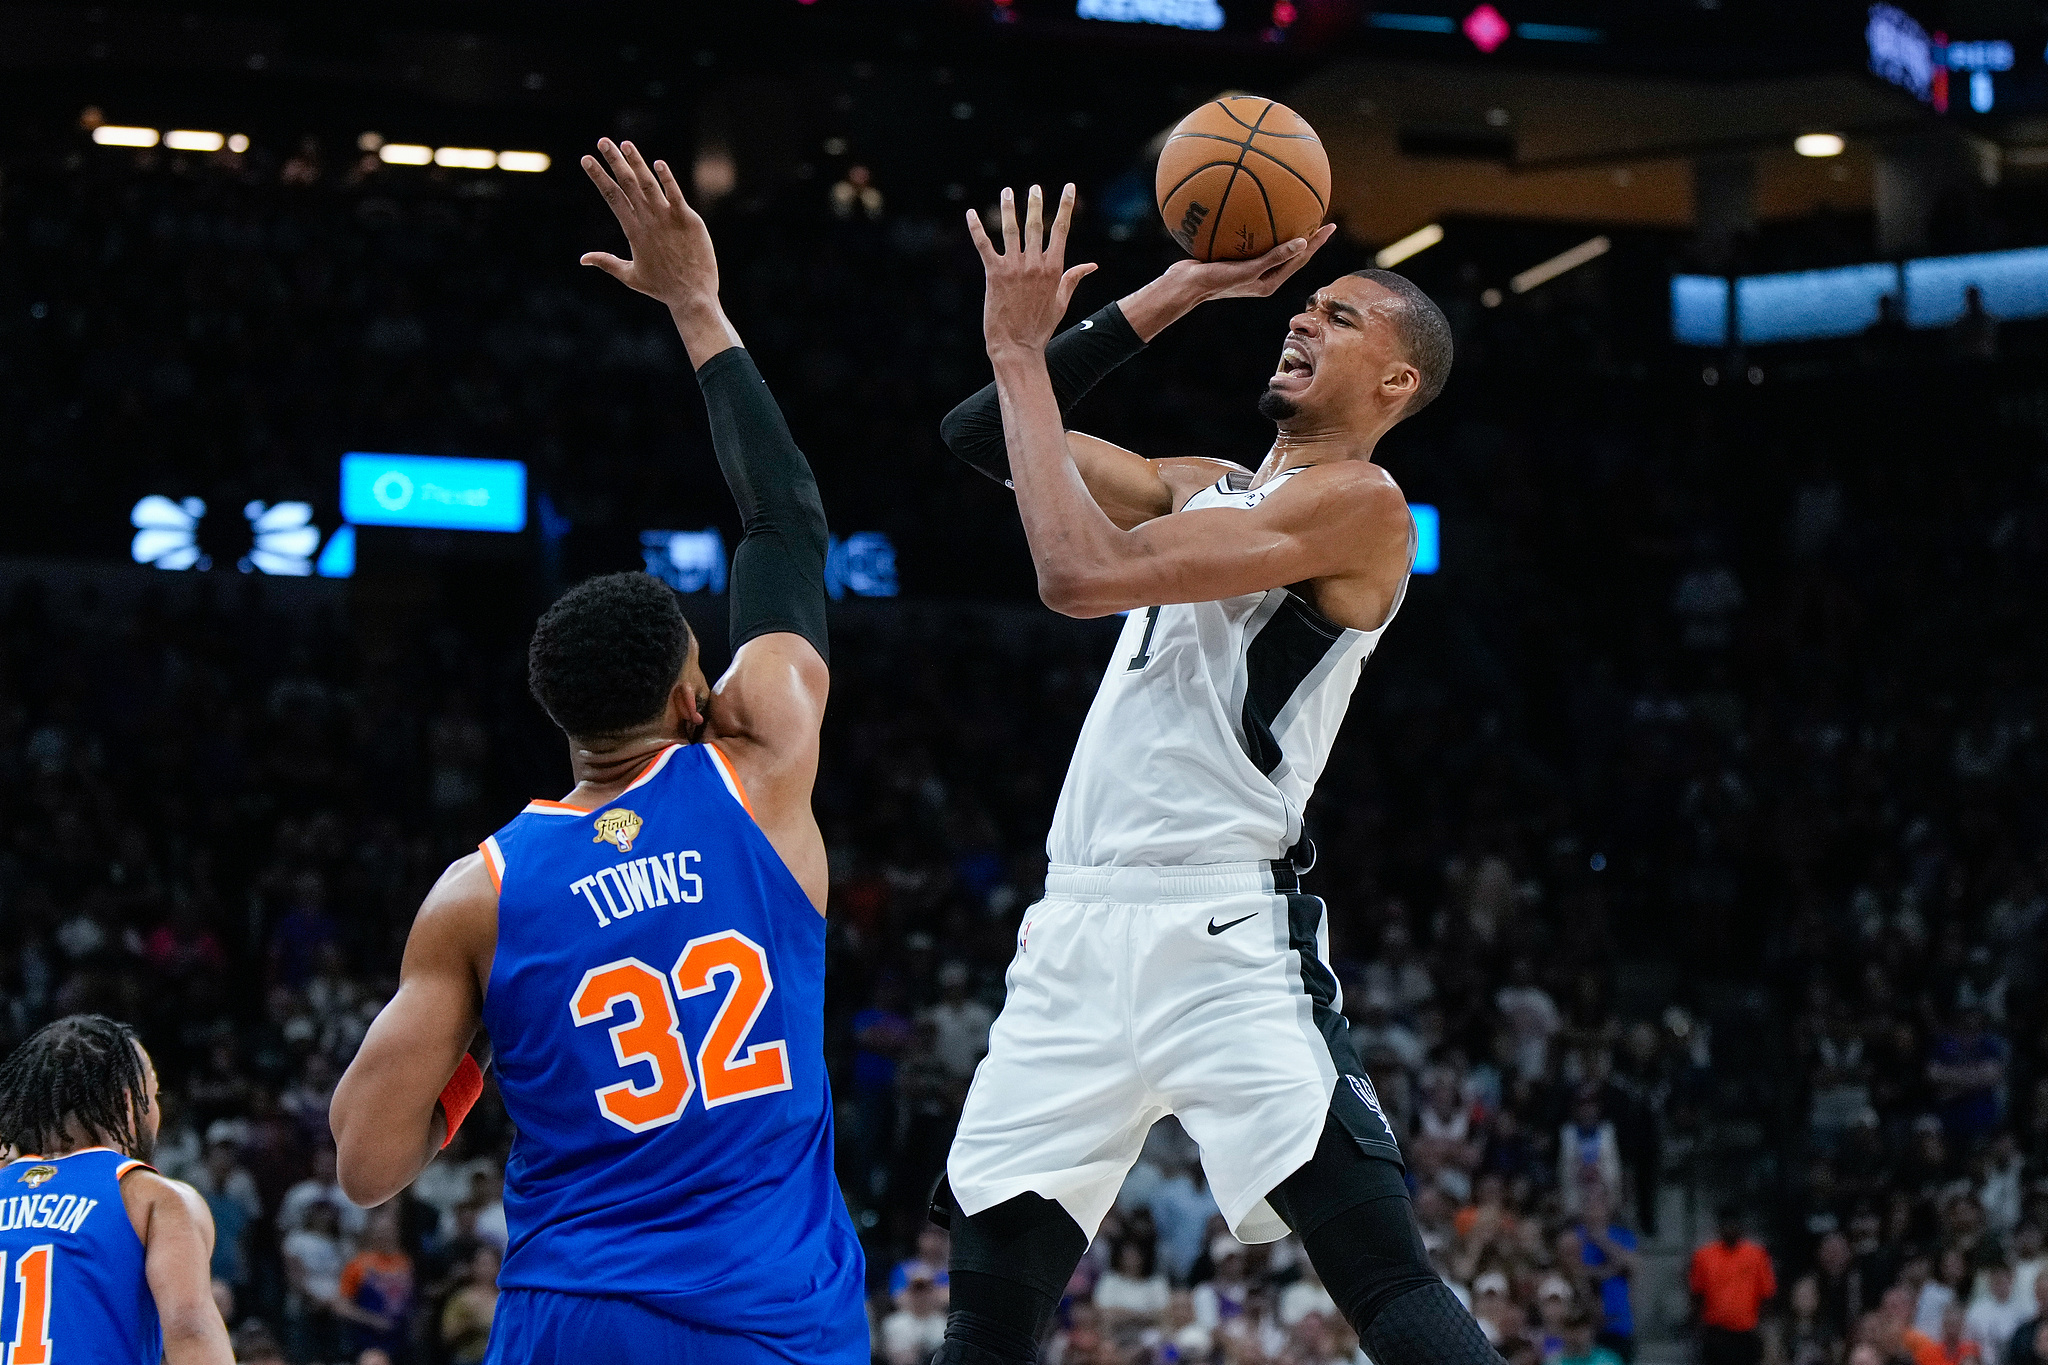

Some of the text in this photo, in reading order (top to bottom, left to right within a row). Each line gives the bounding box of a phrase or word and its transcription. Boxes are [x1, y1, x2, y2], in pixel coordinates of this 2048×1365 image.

[1126, 605, 1162, 672] 1
[596, 812, 640, 840] Finals
[569, 850, 703, 928] TOWNS
[568, 929, 793, 1134] 32
[0, 1243, 54, 1365] 1
